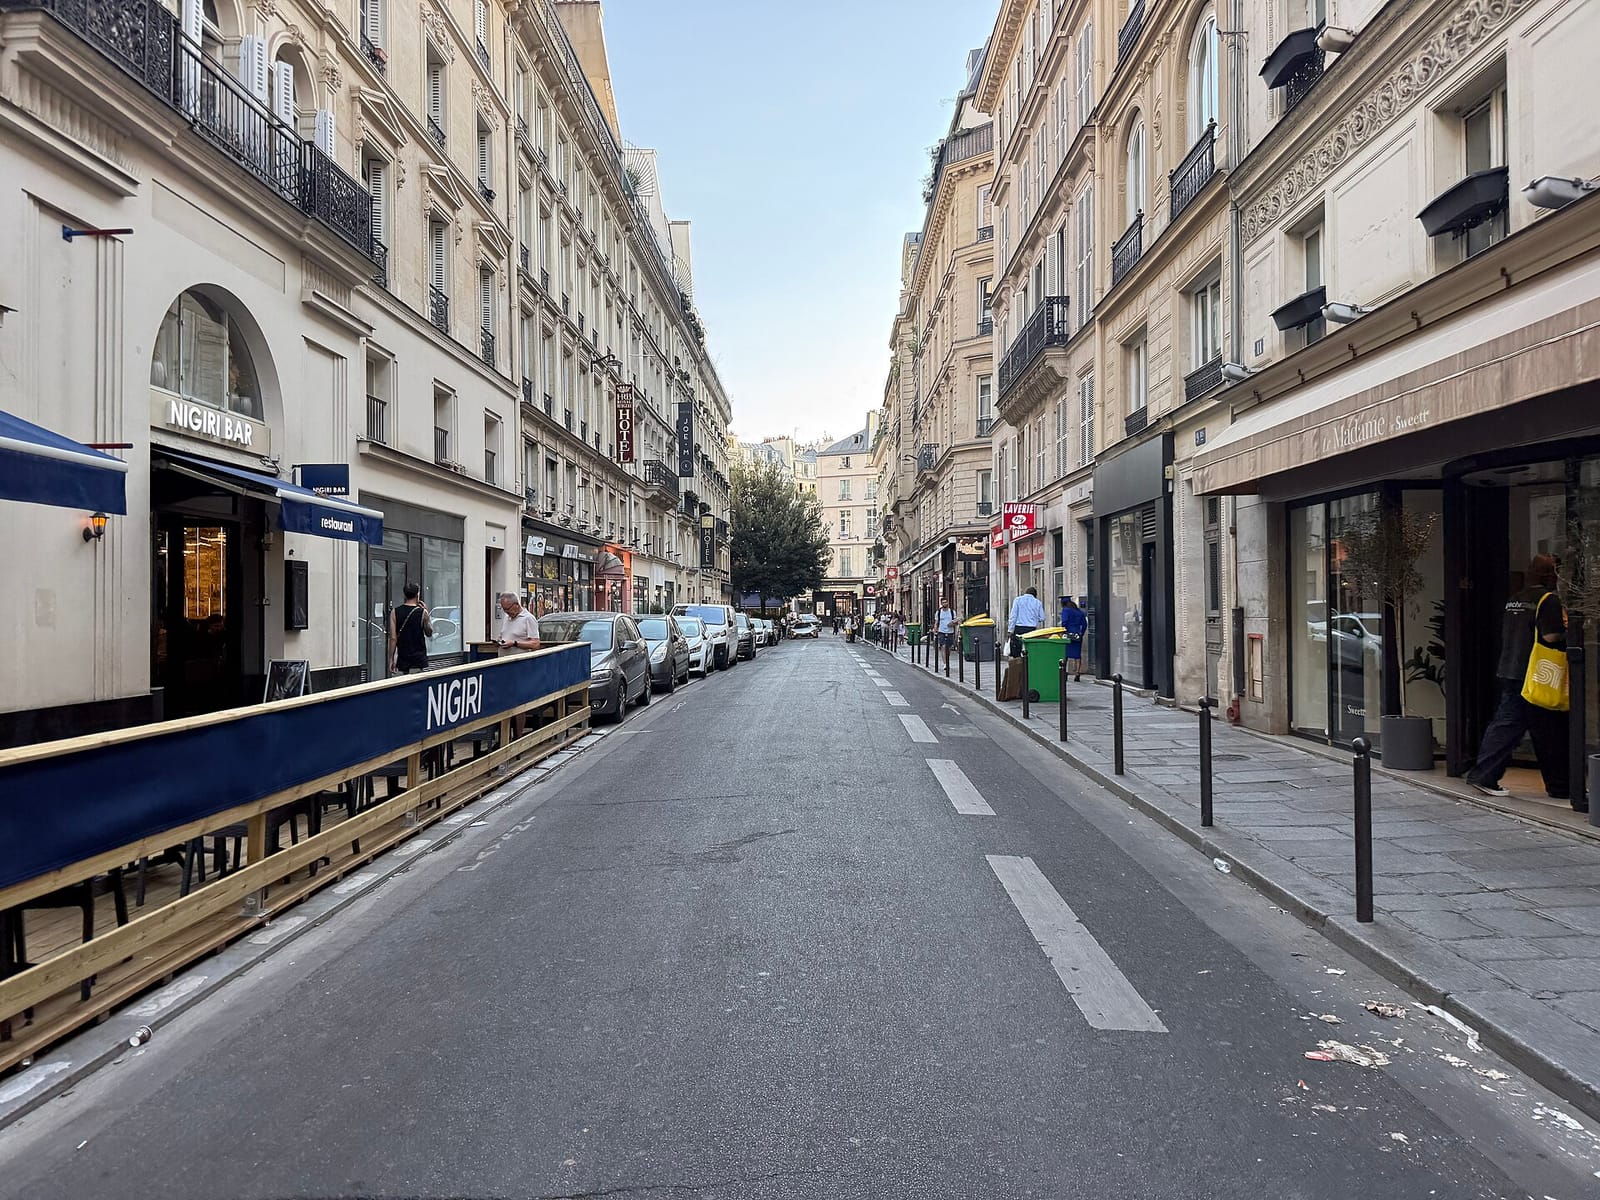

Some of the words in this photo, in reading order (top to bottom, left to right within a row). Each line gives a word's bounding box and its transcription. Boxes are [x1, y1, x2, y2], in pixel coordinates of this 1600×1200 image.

[171, 400, 220, 437] NIGIRI
[225, 417, 253, 446] BAR
[618, 409, 630, 462] HOTEL
[1334, 416, 1385, 449] Madame
[321, 516, 353, 533] restaurant
[1004, 503, 1034, 514] LAVERIE
[426, 674, 483, 730] NIGIRI
